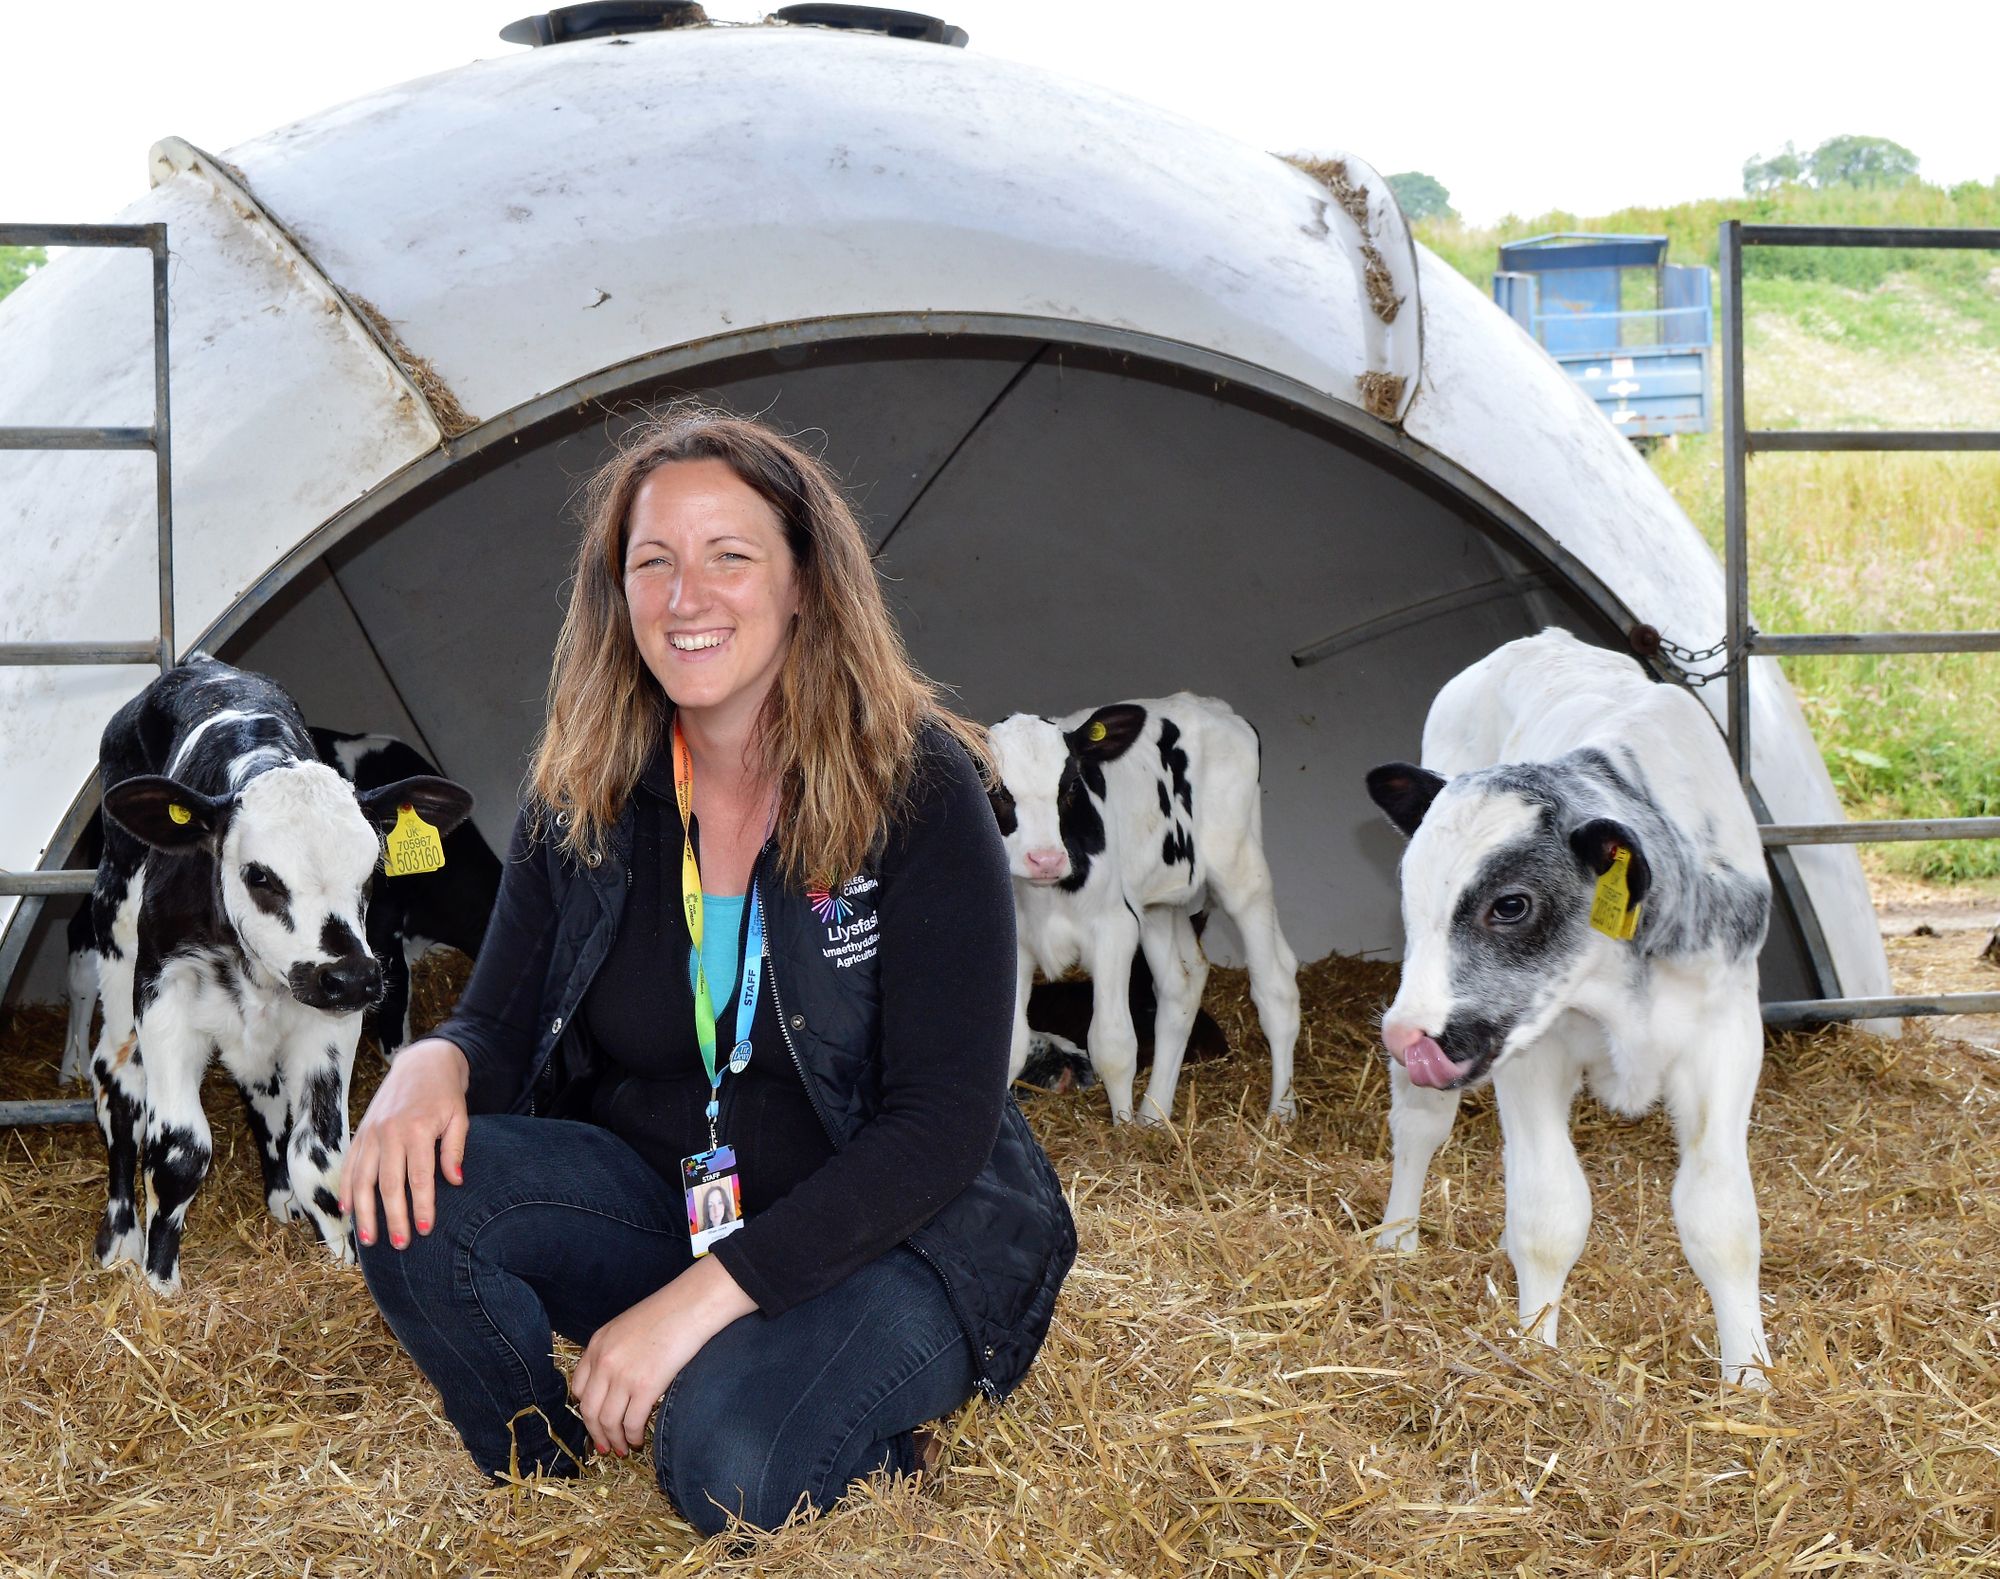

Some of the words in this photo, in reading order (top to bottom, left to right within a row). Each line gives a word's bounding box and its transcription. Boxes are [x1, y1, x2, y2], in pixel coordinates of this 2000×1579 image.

[396, 835, 431, 852] 705967
[405, 827, 419, 838] UK
[396, 845, 441, 873] 503160
[827, 910, 878, 943] Llysfasi
[744, 969, 757, 1007] STAFF
[702, 1172, 720, 1183] STAFF
